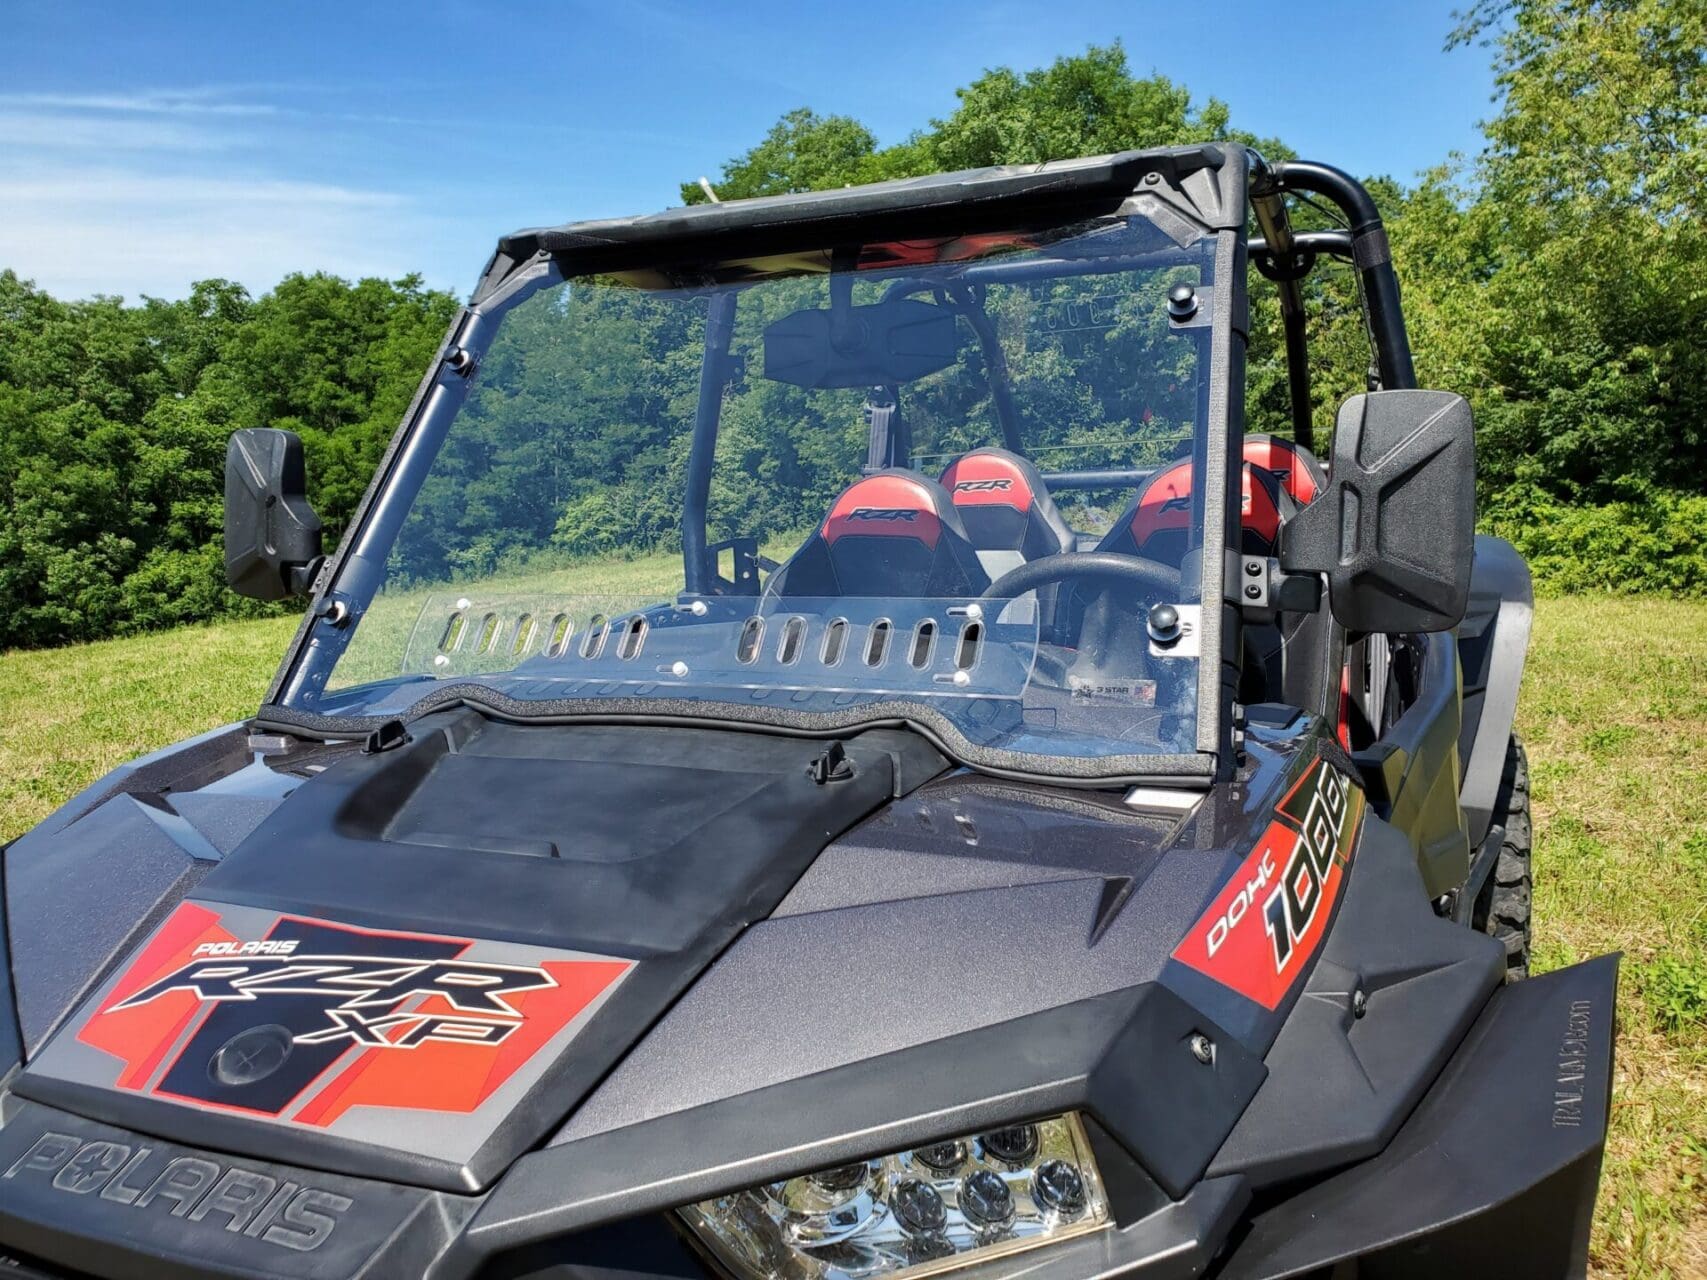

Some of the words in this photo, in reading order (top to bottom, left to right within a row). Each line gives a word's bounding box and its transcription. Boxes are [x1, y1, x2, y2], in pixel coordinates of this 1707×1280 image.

[952, 479, 1013, 494] RZR
[846, 507, 920, 522] RZR
[1262, 760, 1348, 975] 1000
[1206, 847, 1276, 958] DOHC
[191, 940, 300, 957] POLARIS
[102, 954, 561, 1019] RZR
[293, 1008, 524, 1049] XP
[1, 1131, 354, 1252] POLARIS
